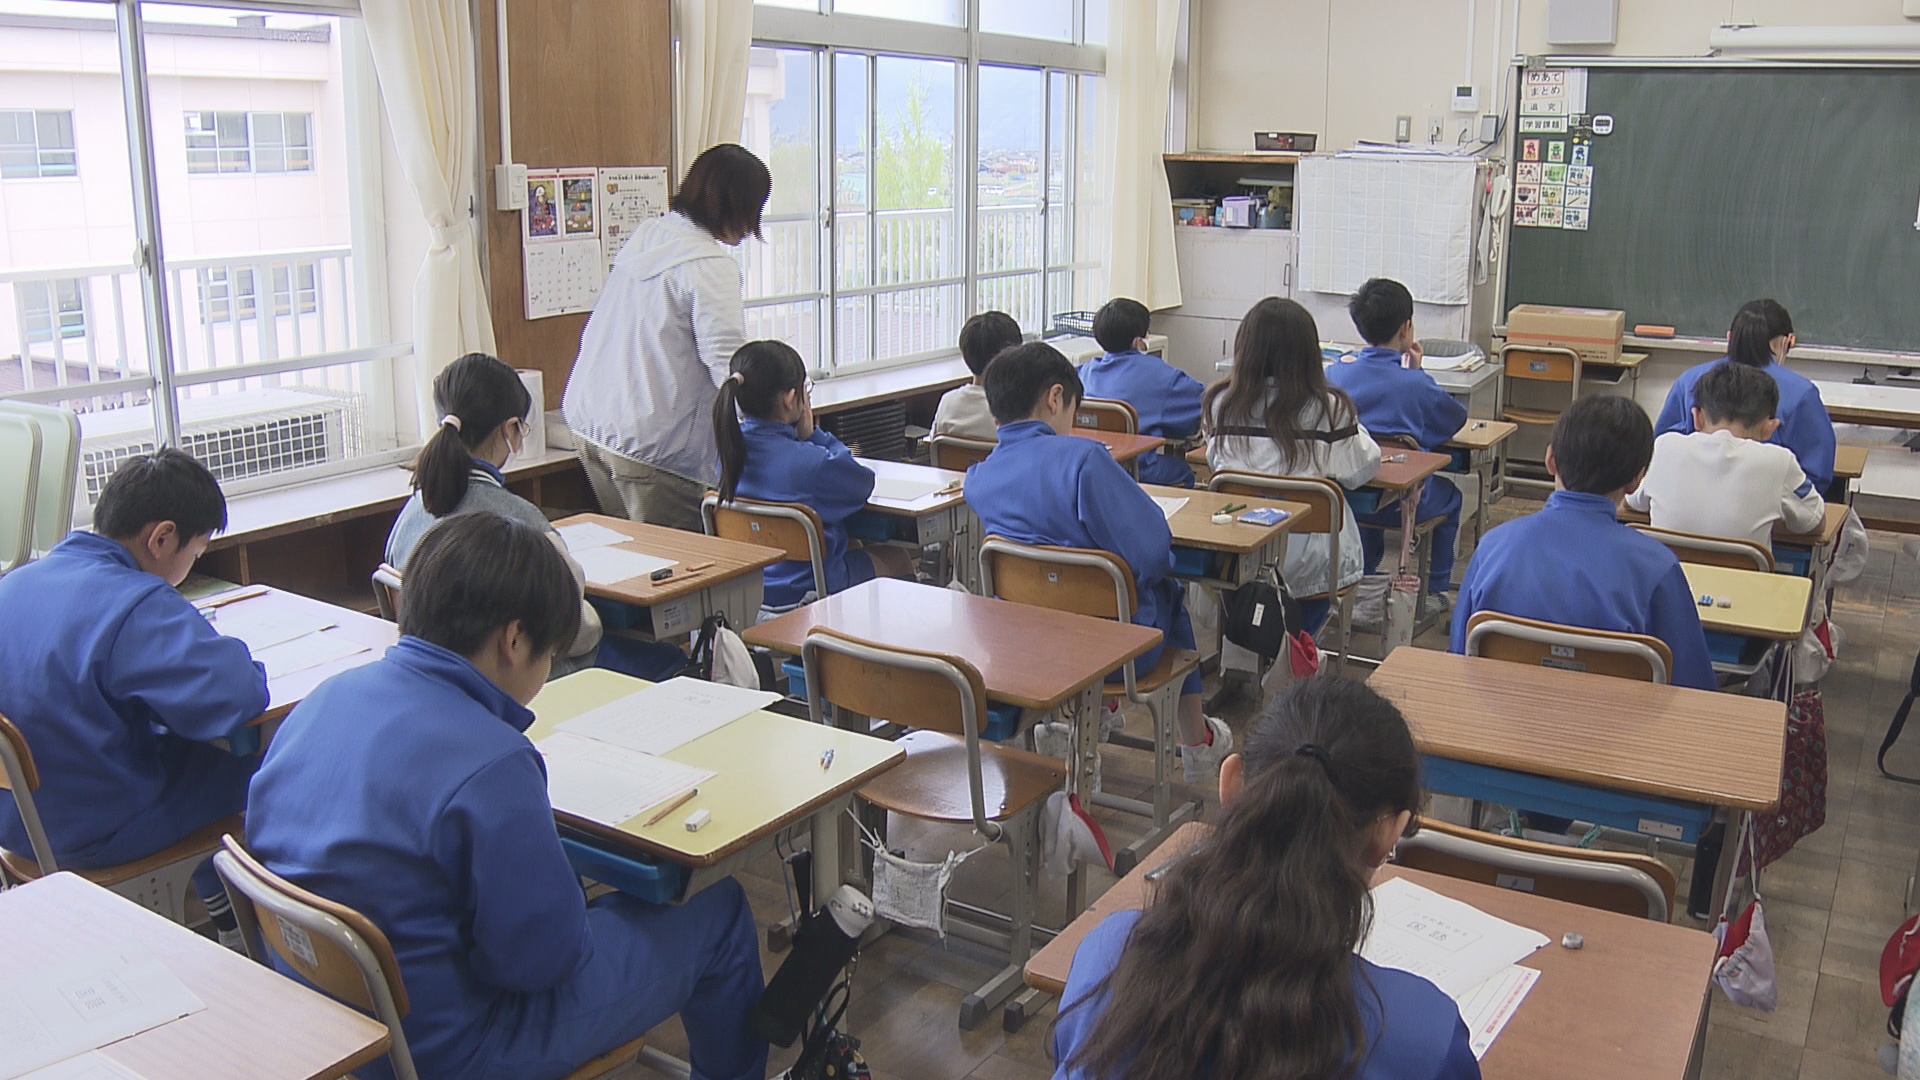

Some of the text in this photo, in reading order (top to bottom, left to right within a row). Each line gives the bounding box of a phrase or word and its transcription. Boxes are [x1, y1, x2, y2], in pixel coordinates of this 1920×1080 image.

[1530, 73, 1560, 82] めあて
[1530, 86, 1560, 97] まとめ
